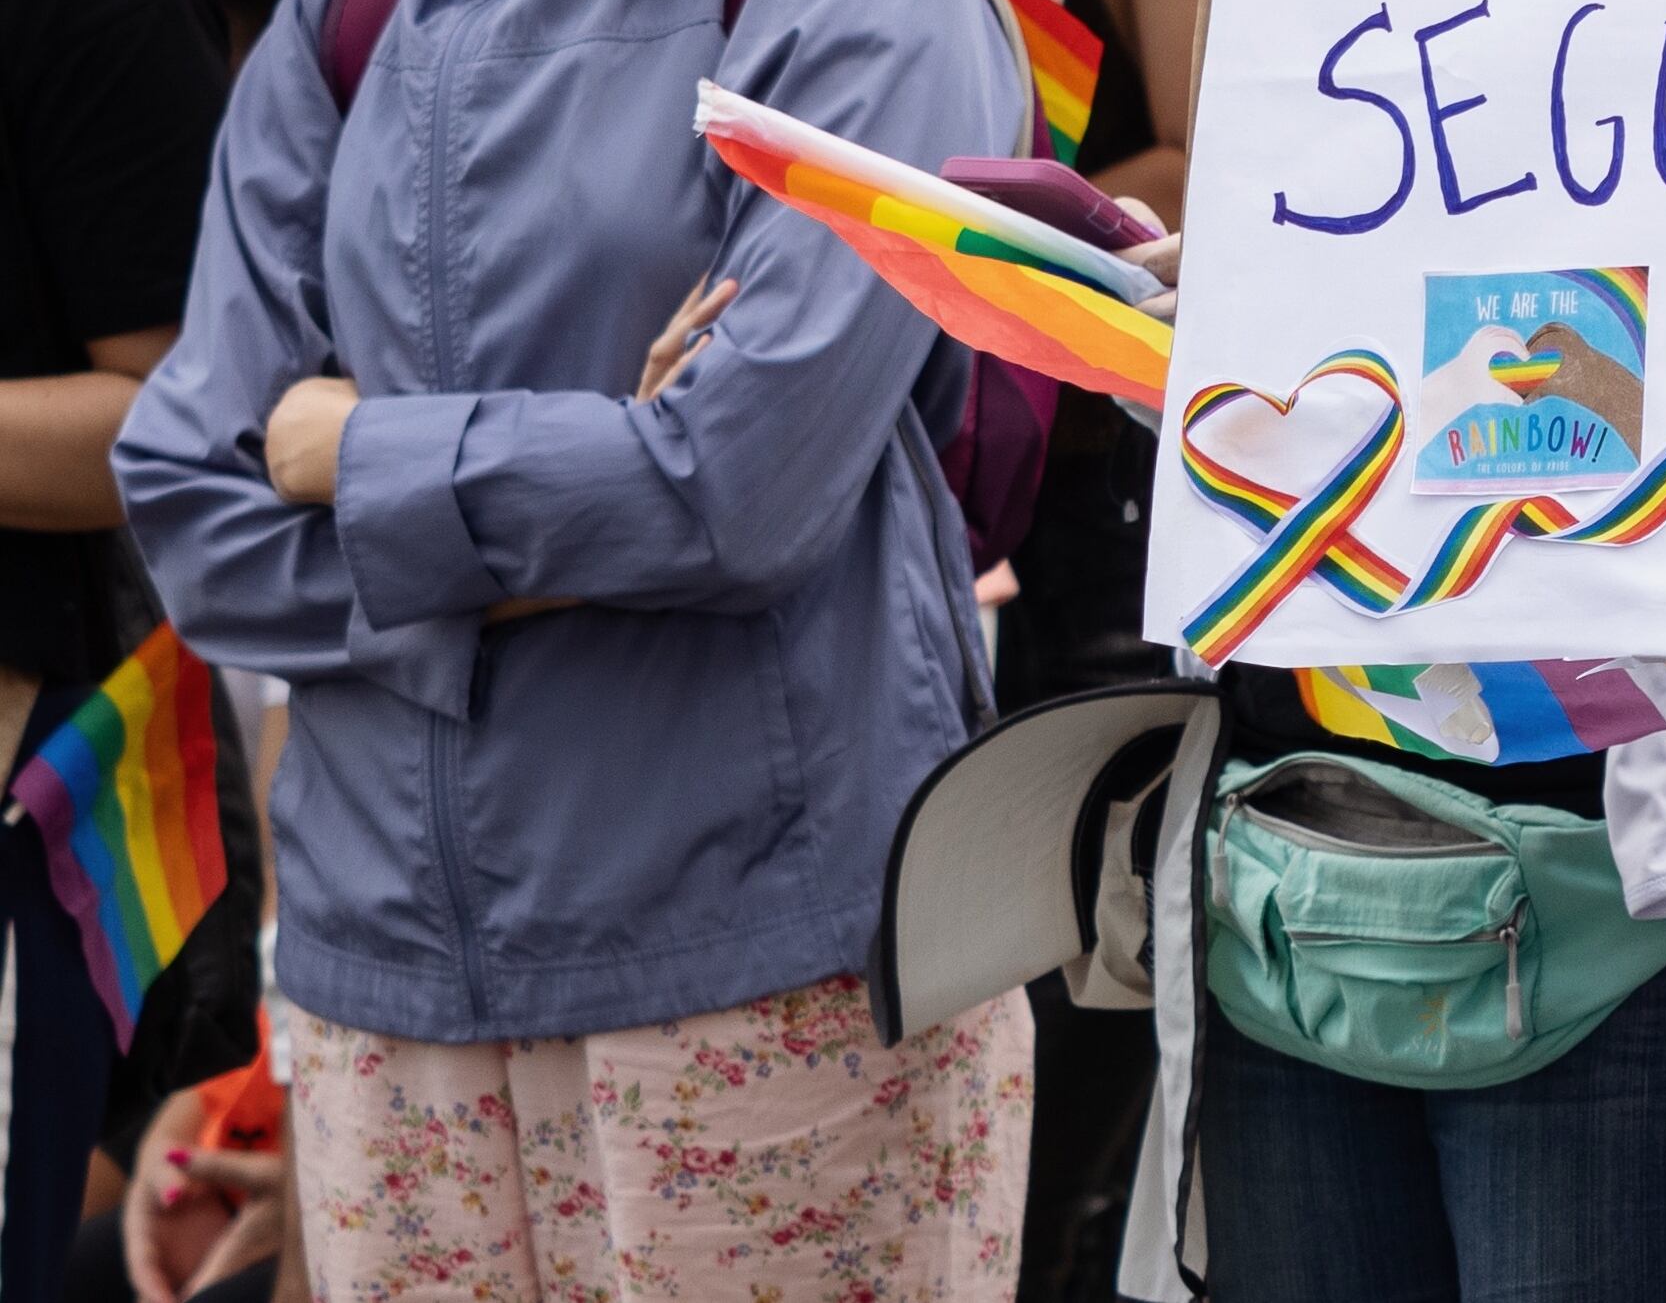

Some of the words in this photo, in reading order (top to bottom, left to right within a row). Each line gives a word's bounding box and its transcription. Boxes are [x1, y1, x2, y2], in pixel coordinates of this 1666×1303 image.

[1475, 295, 1500, 321] WE
[1510, 293, 1539, 319] ARE
[1550, 290, 1578, 315] THE
[1448, 414, 1608, 466] RAINBOW!
